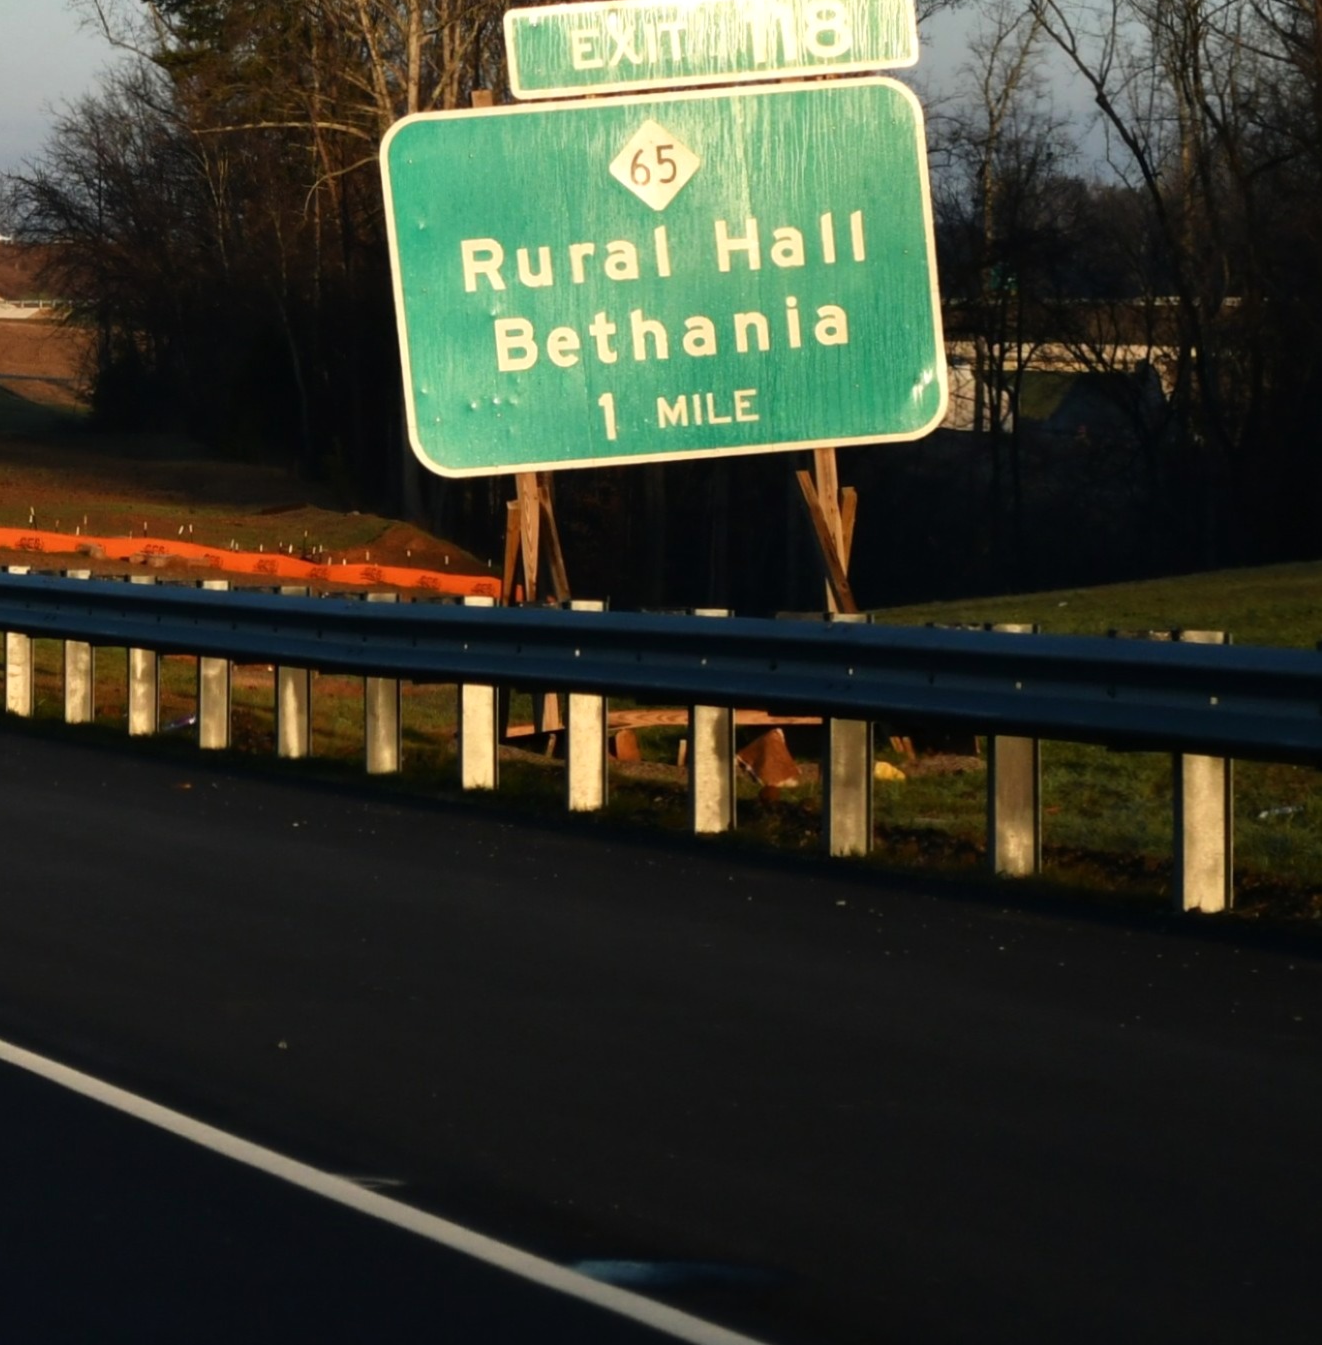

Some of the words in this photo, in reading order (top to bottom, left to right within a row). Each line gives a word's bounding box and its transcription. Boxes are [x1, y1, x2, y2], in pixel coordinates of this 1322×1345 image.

[572, 21, 689, 69] EXIT
[745, 0, 853, 63] 118
[630, 144, 677, 185] 65
[461, 225, 671, 292] Rural
[714, 210, 866, 271] Hall
[495, 296, 848, 372] Bethania
[598, 393, 617, 441] 1
[658, 389, 759, 428] MILE
